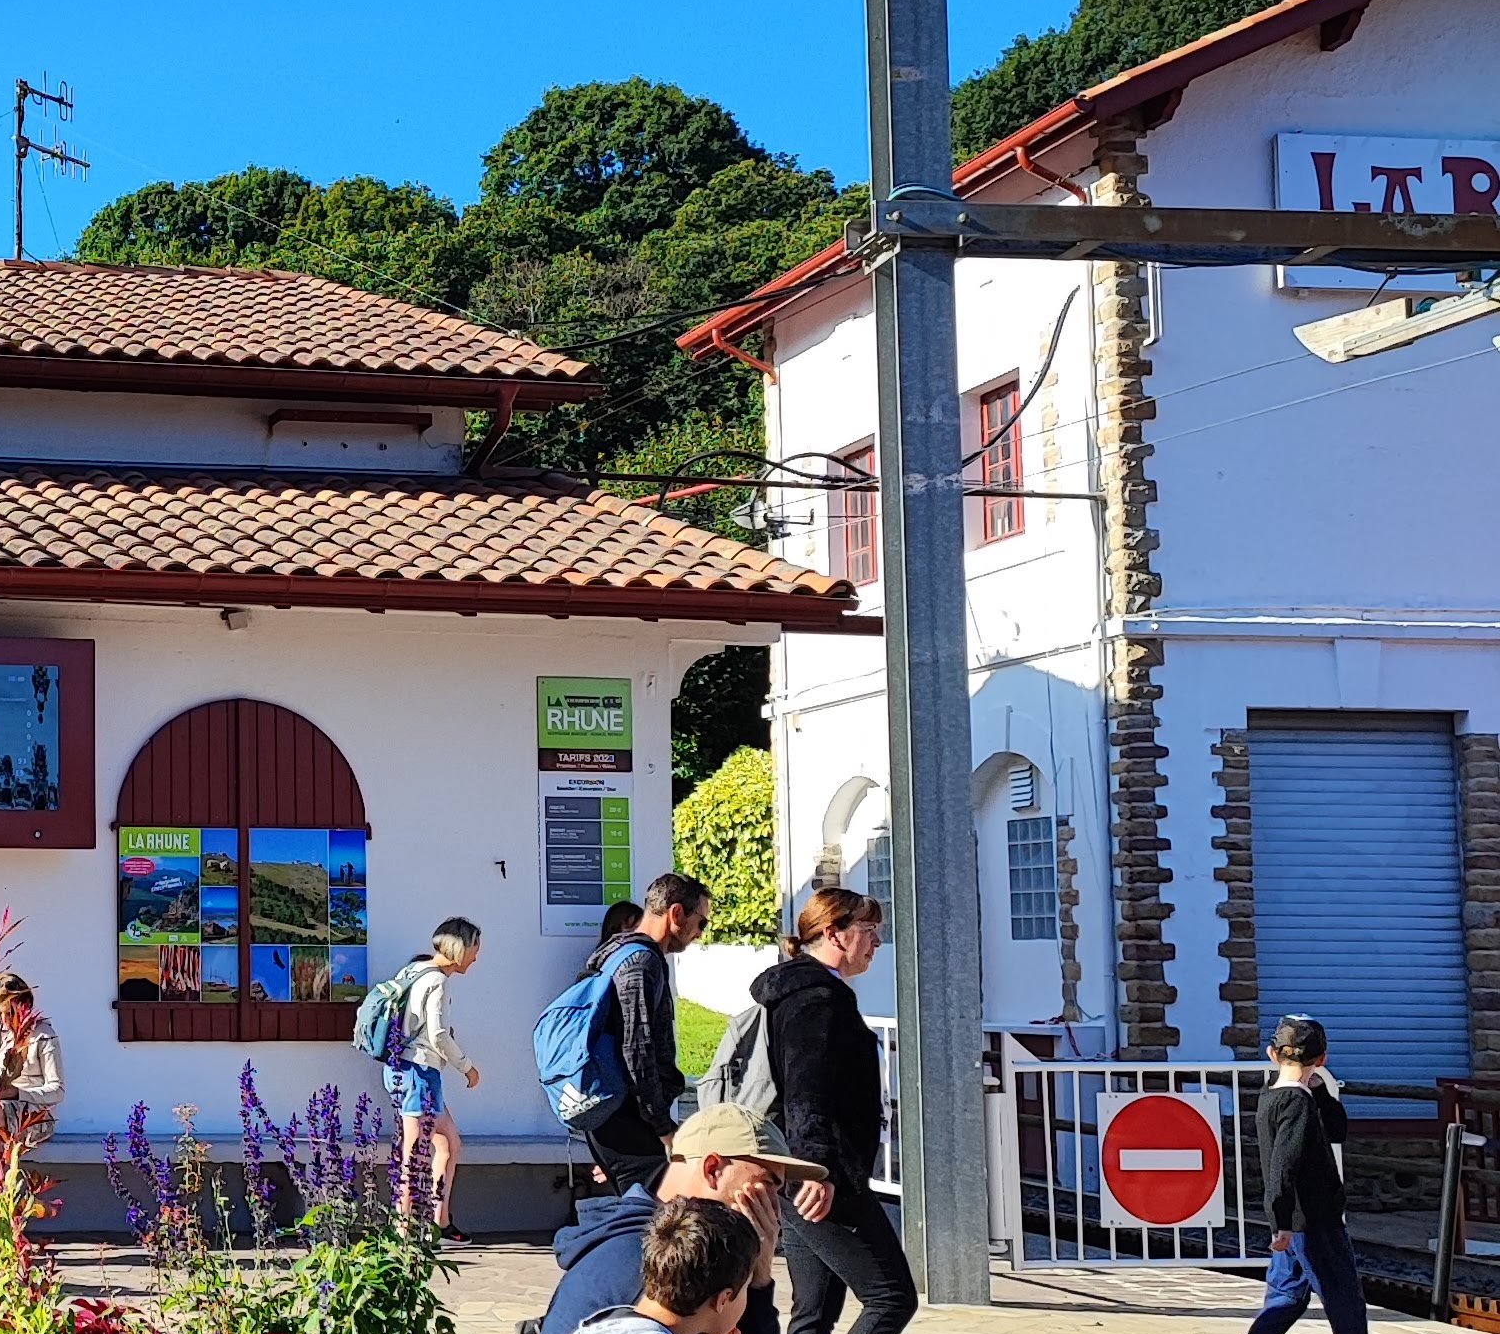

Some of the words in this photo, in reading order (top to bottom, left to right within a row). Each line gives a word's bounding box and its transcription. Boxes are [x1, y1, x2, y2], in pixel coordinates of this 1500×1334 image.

[547, 695, 563, 707] LA
[547, 708, 624, 732] RHUNE
[557, 752, 591, 763] TARIFS
[128, 832, 145, 849] LA
[146, 832, 190, 850] RHUNE
